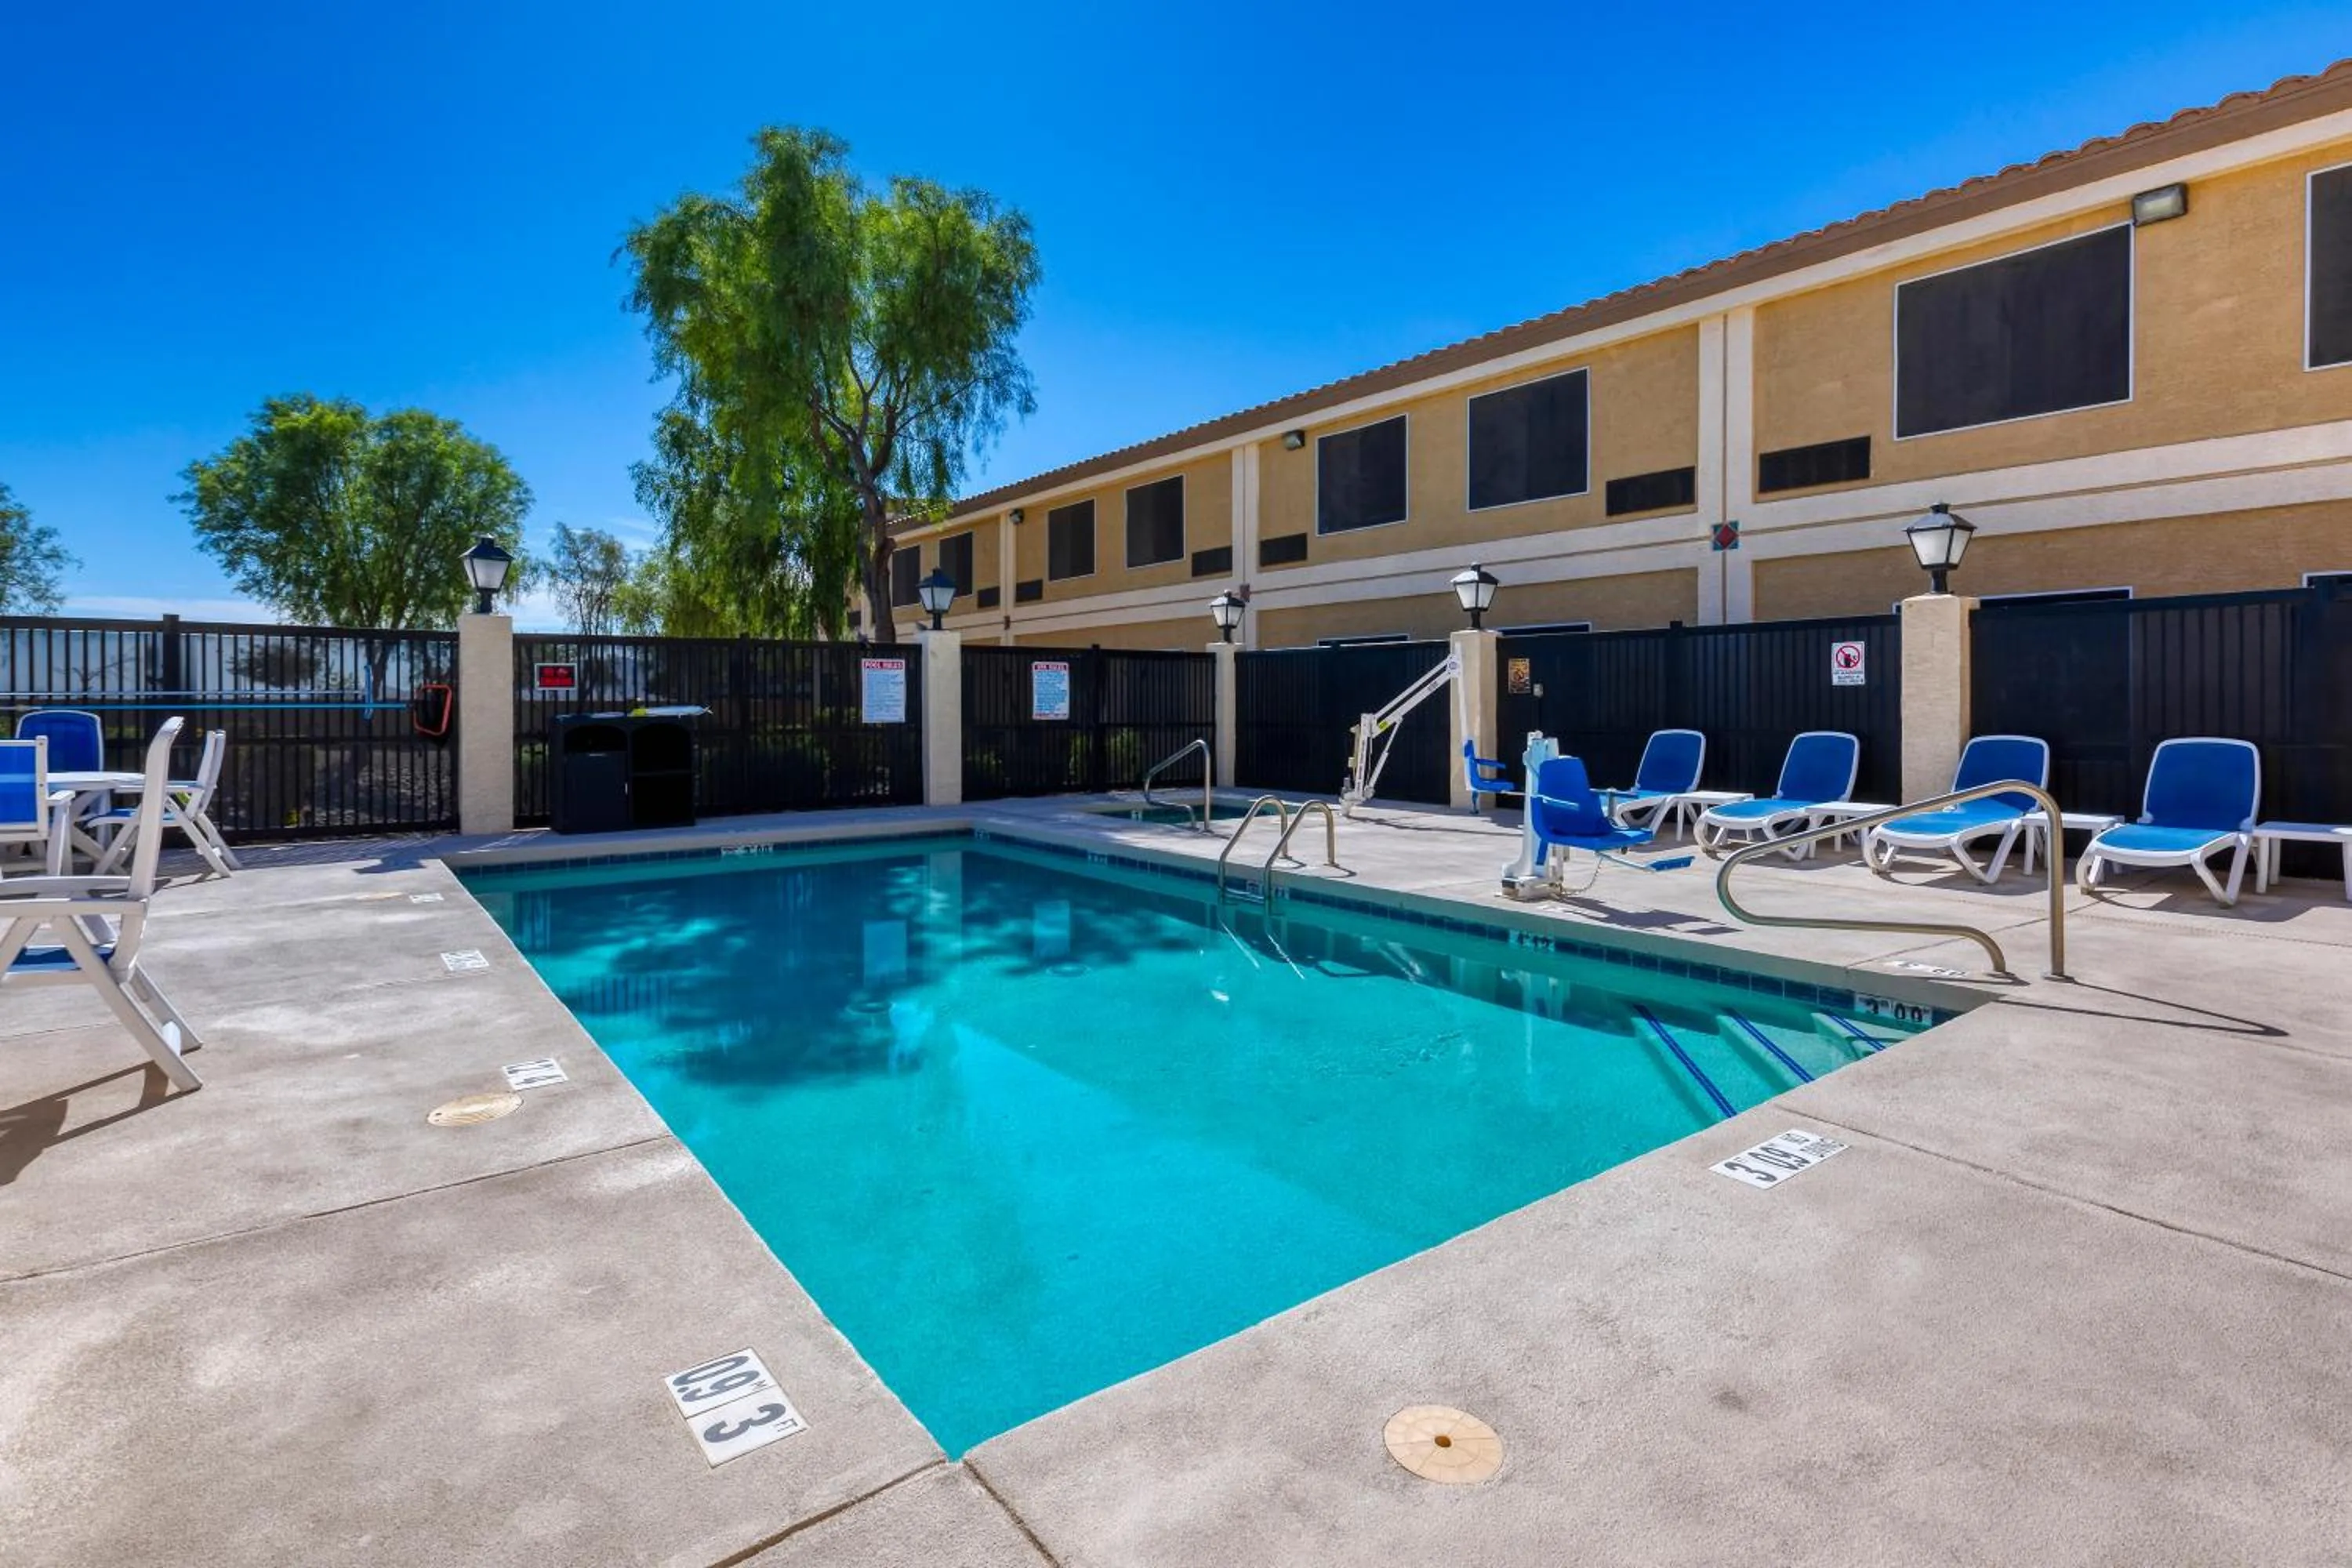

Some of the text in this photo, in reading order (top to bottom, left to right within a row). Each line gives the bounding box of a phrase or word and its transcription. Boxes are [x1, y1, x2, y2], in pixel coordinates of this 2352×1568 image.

[1724, 1161, 1777, 1182] 3
[672, 1356, 760, 1403] 0.9
[703, 1403, 786, 1443] 3
